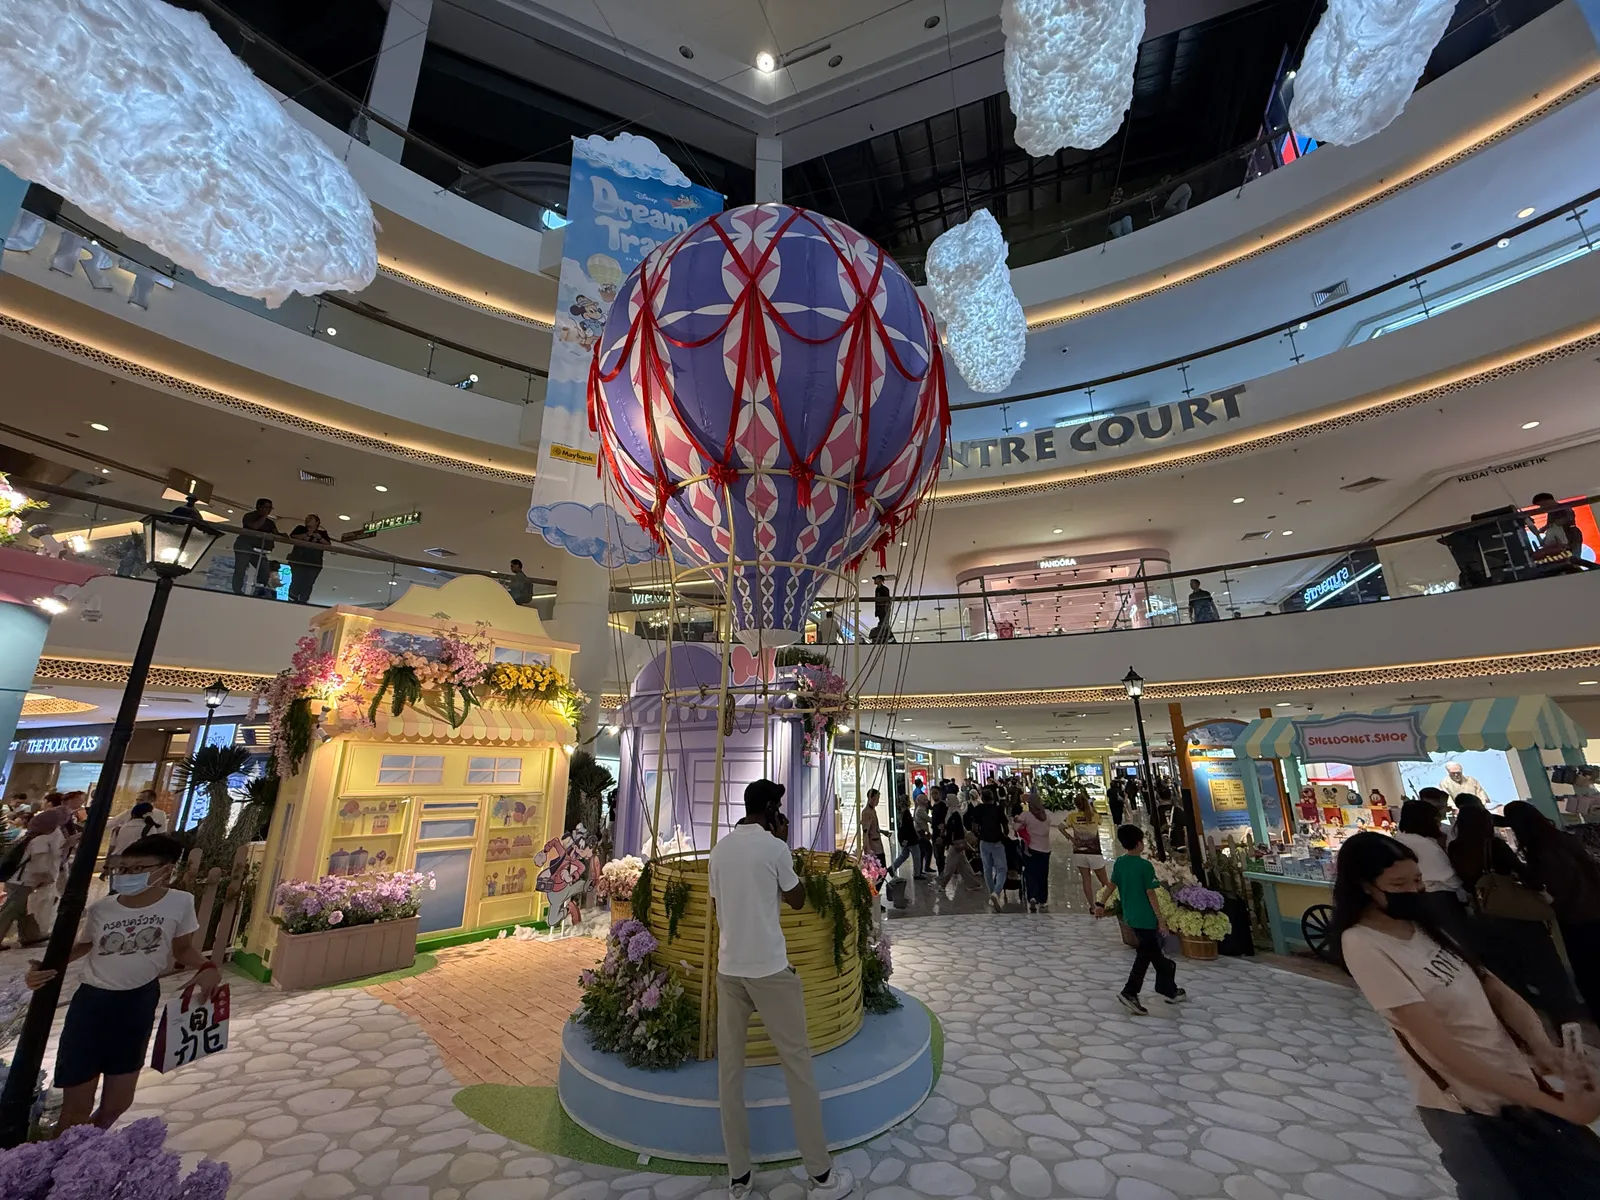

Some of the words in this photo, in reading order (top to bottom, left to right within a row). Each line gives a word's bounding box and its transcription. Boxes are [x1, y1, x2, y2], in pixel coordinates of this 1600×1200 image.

[590, 175, 688, 233] Dream
[594, 215, 663, 258] Tra
[1070, 384, 1246, 451] COURT
[562, 450, 593, 461] Maybank
[1458, 470, 1489, 483] KEDAI
[1490, 456, 1547, 474] KOSMETIK
[26, 739, 43, 753] THE
[43, 738, 69, 753] HOUR
[69, 736, 99, 752] GLASS
